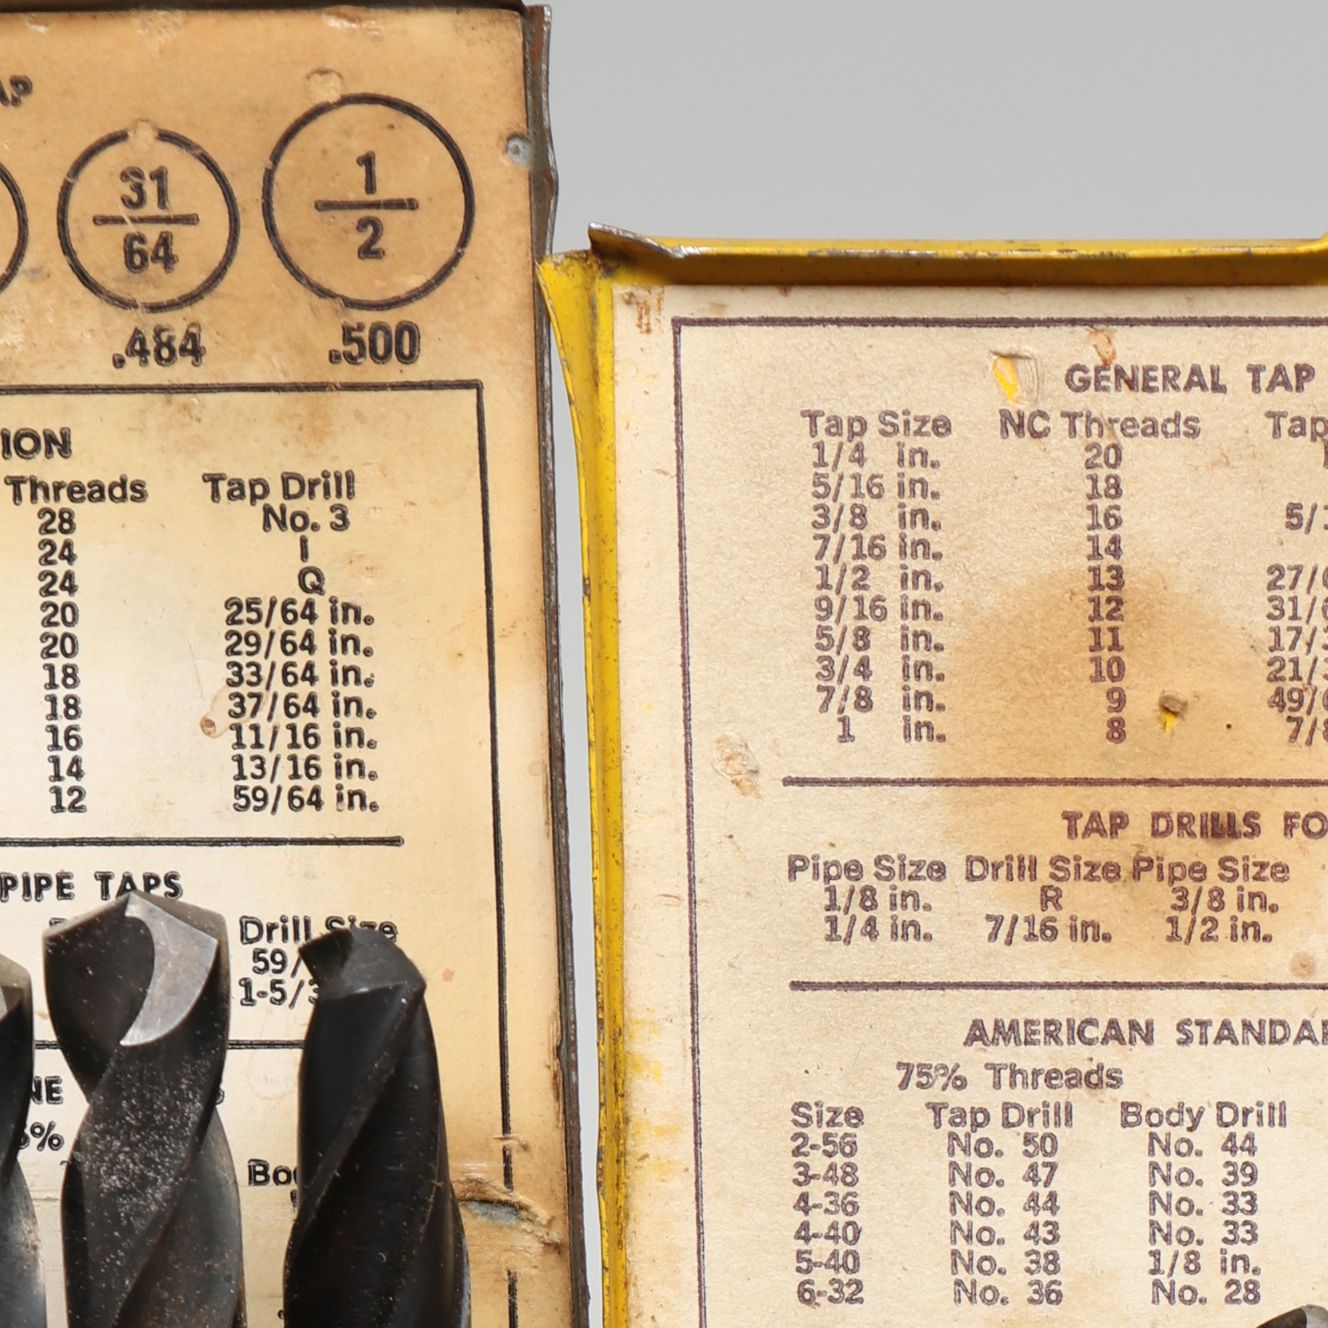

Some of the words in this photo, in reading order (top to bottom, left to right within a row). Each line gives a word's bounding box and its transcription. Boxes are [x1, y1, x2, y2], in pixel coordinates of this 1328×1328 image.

[119, 165, 170, 211] 31
[355, 150, 378, 196] 1
[122, 230, 180, 275] 64
[355, 215, 386, 261] 2
[111, 321, 207, 370] .484
[328, 320, 422, 366] .500
[1064, 362, 1228, 395] GENERAL
[1245, 362, 1316, 395] TAP
[799, 409, 868, 444] Tap
[877, 408, 953, 439] Size
[998, 408, 1051, 440] NC
[1059, 409, 1202, 440] Threads
[812, 439, 868, 473] 1/4
[896, 441, 941, 470] in.
[1084, 441, 1123, 470] 20
[3, 473, 149, 507] Threads
[201, 472, 271, 507] Tap
[279, 468, 356, 501] Drill
[811, 471, 886, 504] 5/16
[896, 471, 941, 501] in.
[1085, 473, 1123, 501] 18
[36, 506, 77, 536] 28
[1085, 503, 1124, 532] 16
[37, 537, 78, 567] 24
[1086, 533, 1124, 562] 14
[814, 562, 871, 596] 1/2
[899, 563, 945, 593] in.
[223, 595, 320, 629] 25/64
[328, 595, 375, 627] in.
[815, 684, 874, 716] 7/8
[901, 684, 946, 713] in.
[1105, 686, 1127, 714] 9
[44, 723, 84, 753] 16
[836, 714, 856, 744] 1
[902, 714, 947, 744] in.
[1105, 716, 1127, 745] 8
[48, 784, 88, 815] 12
[232, 783, 325, 816] 59/64
[334, 782, 380, 813] in.
[1060, 810, 1130, 841] TAP
[1150, 810, 1262, 840] DRILLS
[787, 853, 864, 886] Pipe
[873, 853, 947, 883] Size
[964, 853, 1038, 883] Drill
[1048, 854, 1122, 884] Size
[1128, 850, 1208, 887] Pipe
[1217, 855, 1291, 884] Size
[93, 870, 184, 906] TAPS
[823, 884, 879, 916] 1/8
[889, 884, 933, 913] in.
[1039, 884, 1064, 913] R
[238, 914, 312, 946] Drill
[823, 914, 880, 946] 1/4
[890, 914, 934, 943] in.
[984, 913, 1059, 947] 7/16
[1068, 914, 1113, 944] in.
[962, 1017, 1155, 1048] AMERICAN
[895, 1060, 969, 1092] 75%
[983, 1062, 1124, 1091] Threads
[790, 1100, 865, 1129] Size
[924, 1101, 991, 1134] Tap
[1001, 1100, 1074, 1130] Drill
[1119, 1100, 1206, 1133] Body
[1215, 1100, 1288, 1129] Drill
[789, 1131, 859, 1159] 2-56
[946, 1130, 1005, 1159] No.
[1021, 1131, 1059, 1159] 50
[1147, 1131, 1204, 1158] No.
[1220, 1131, 1258, 1158] 44
[796, 1277, 865, 1309] 6-32
[953, 1278, 1010, 1307] No.
[1026, 1279, 1064, 1306] 36
[1151, 1278, 1208, 1306] No.
[1223, 1277, 1261, 1306] 28
